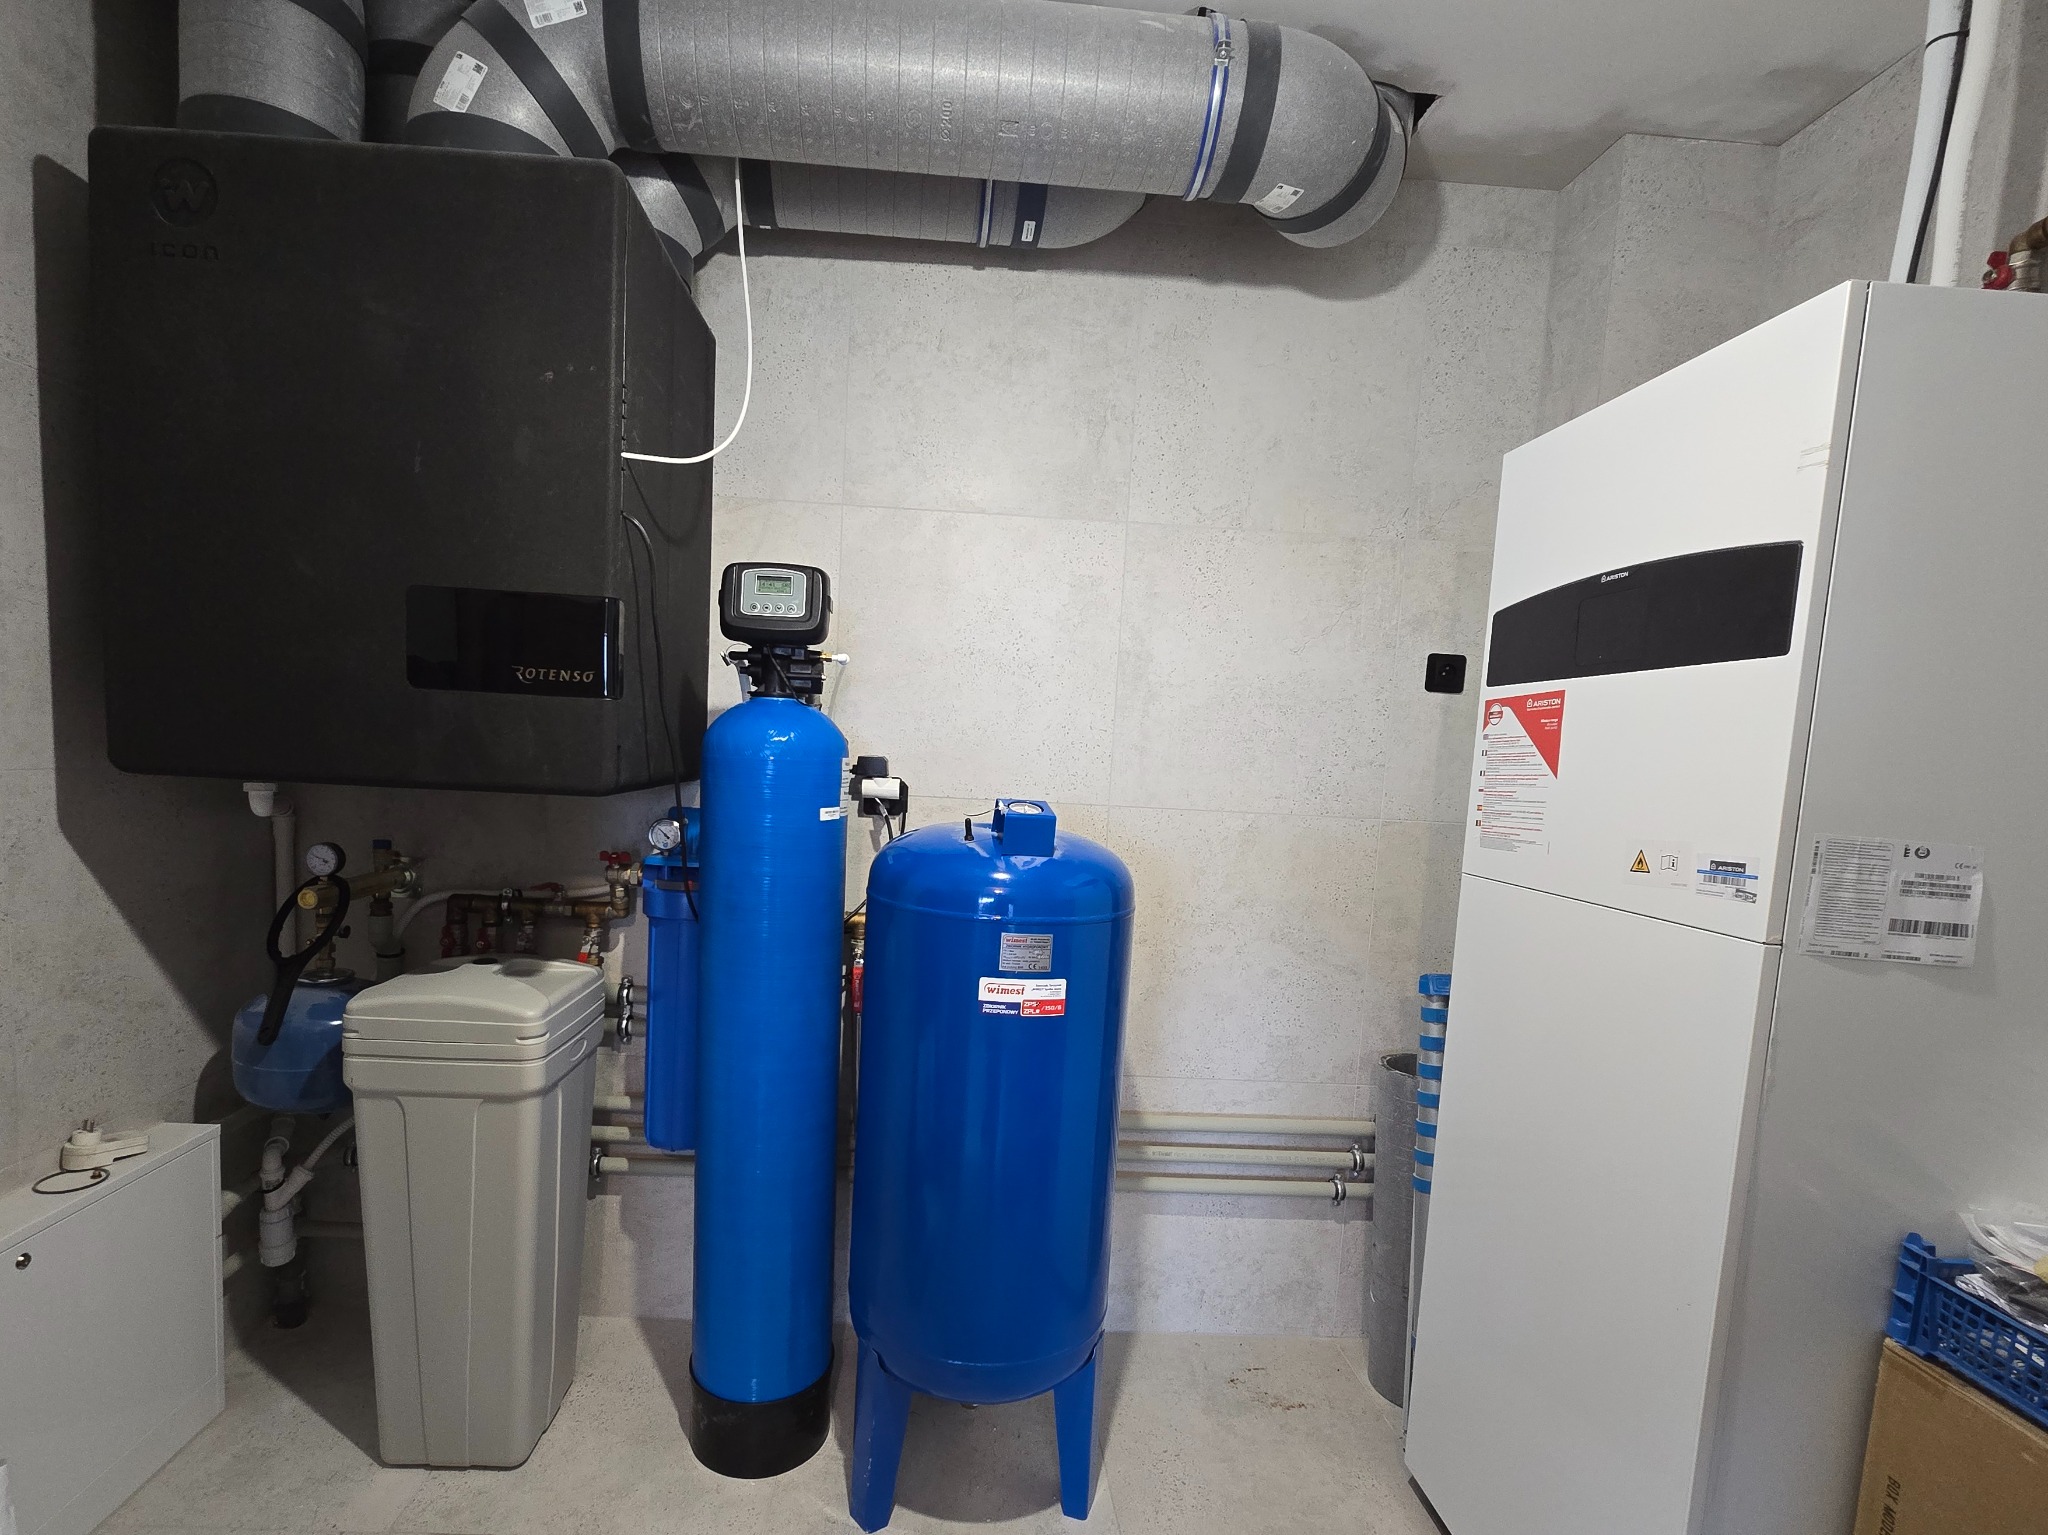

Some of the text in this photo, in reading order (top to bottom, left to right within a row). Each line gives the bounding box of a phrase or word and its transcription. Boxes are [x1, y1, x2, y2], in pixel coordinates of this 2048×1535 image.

[1606, 571, 1629, 581] ARISTON
[511, 665, 596, 684] ROTENSO
[1532, 698, 1561, 708] ARISTON
[1717, 864, 1745, 874] ARISTON
[986, 985, 1026, 996] wimest
[1878, 1475, 1901, 1535] BOX MODE
